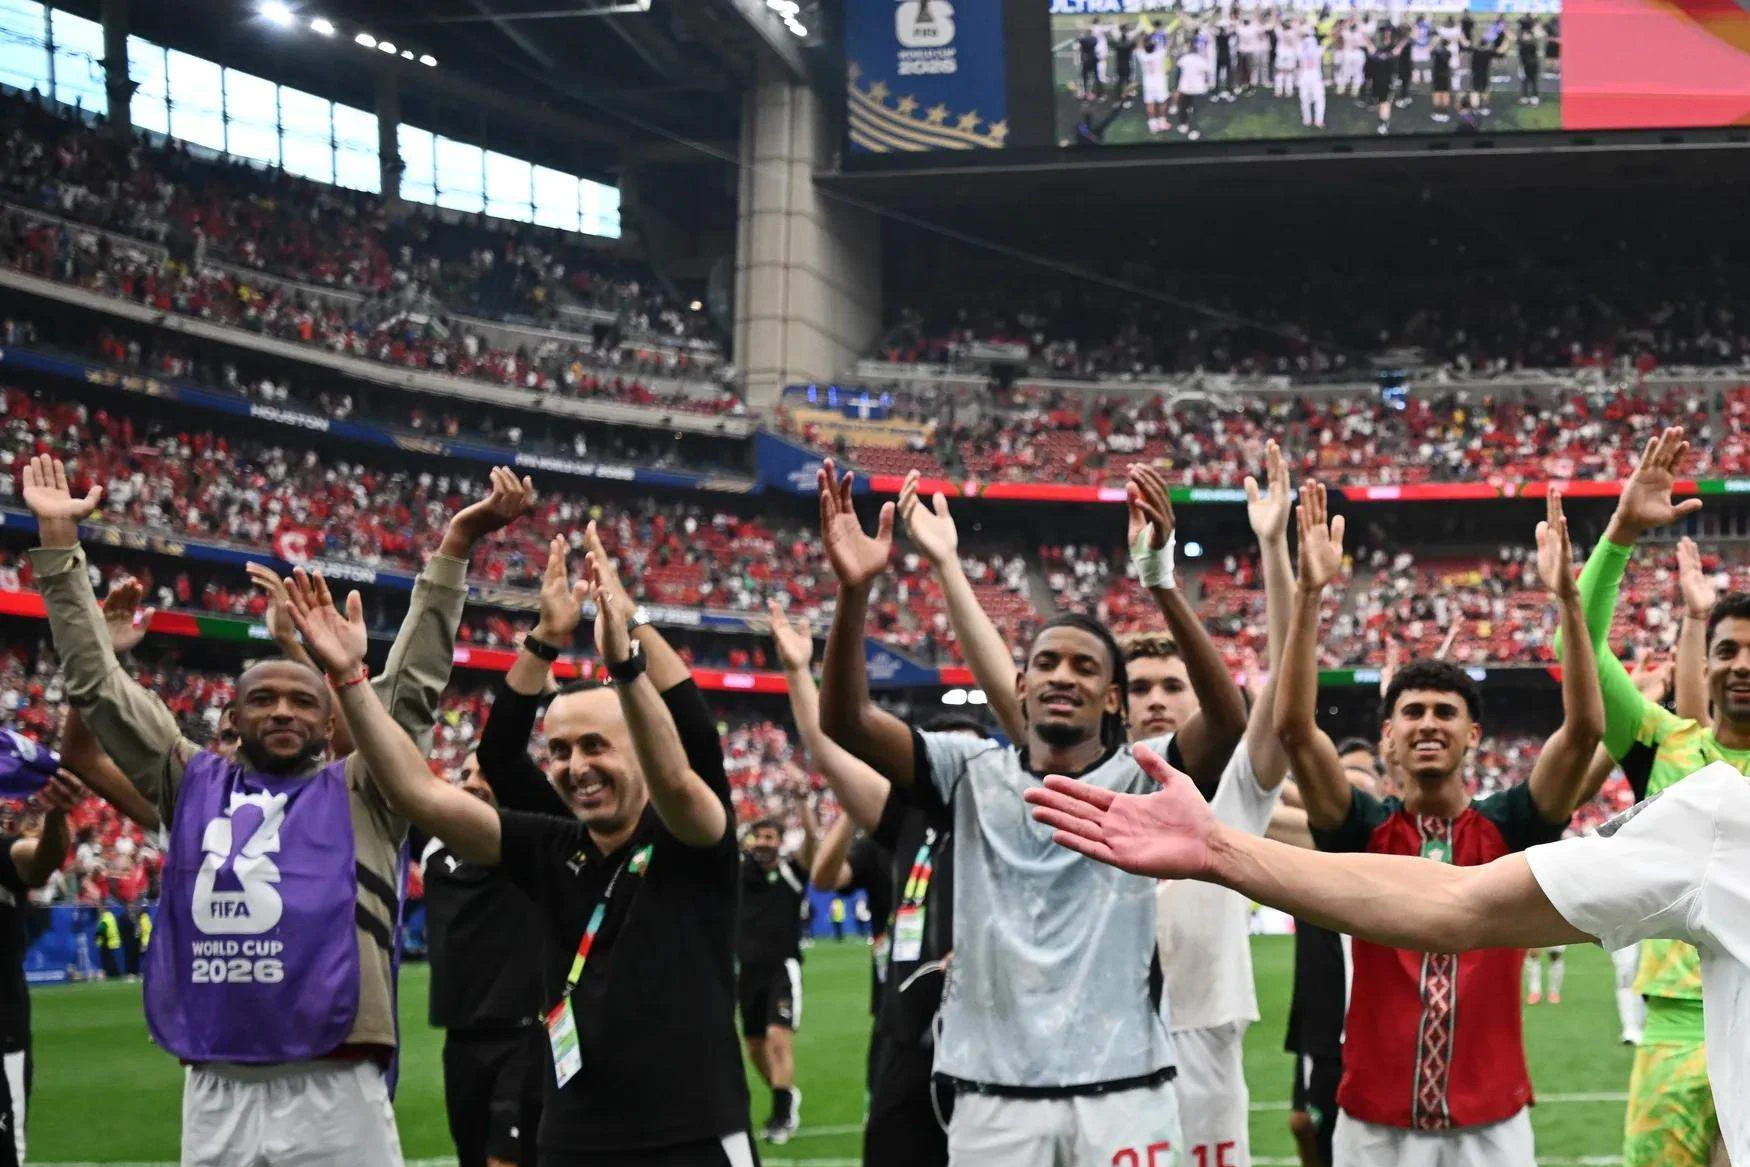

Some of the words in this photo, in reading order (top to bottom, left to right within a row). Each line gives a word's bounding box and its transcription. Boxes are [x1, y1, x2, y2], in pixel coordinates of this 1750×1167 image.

[210, 901, 251, 919] FIFA
[192, 939, 239, 957] WORLD
[242, 939, 284, 956] CUP
[191, 958, 285, 984] 2026
